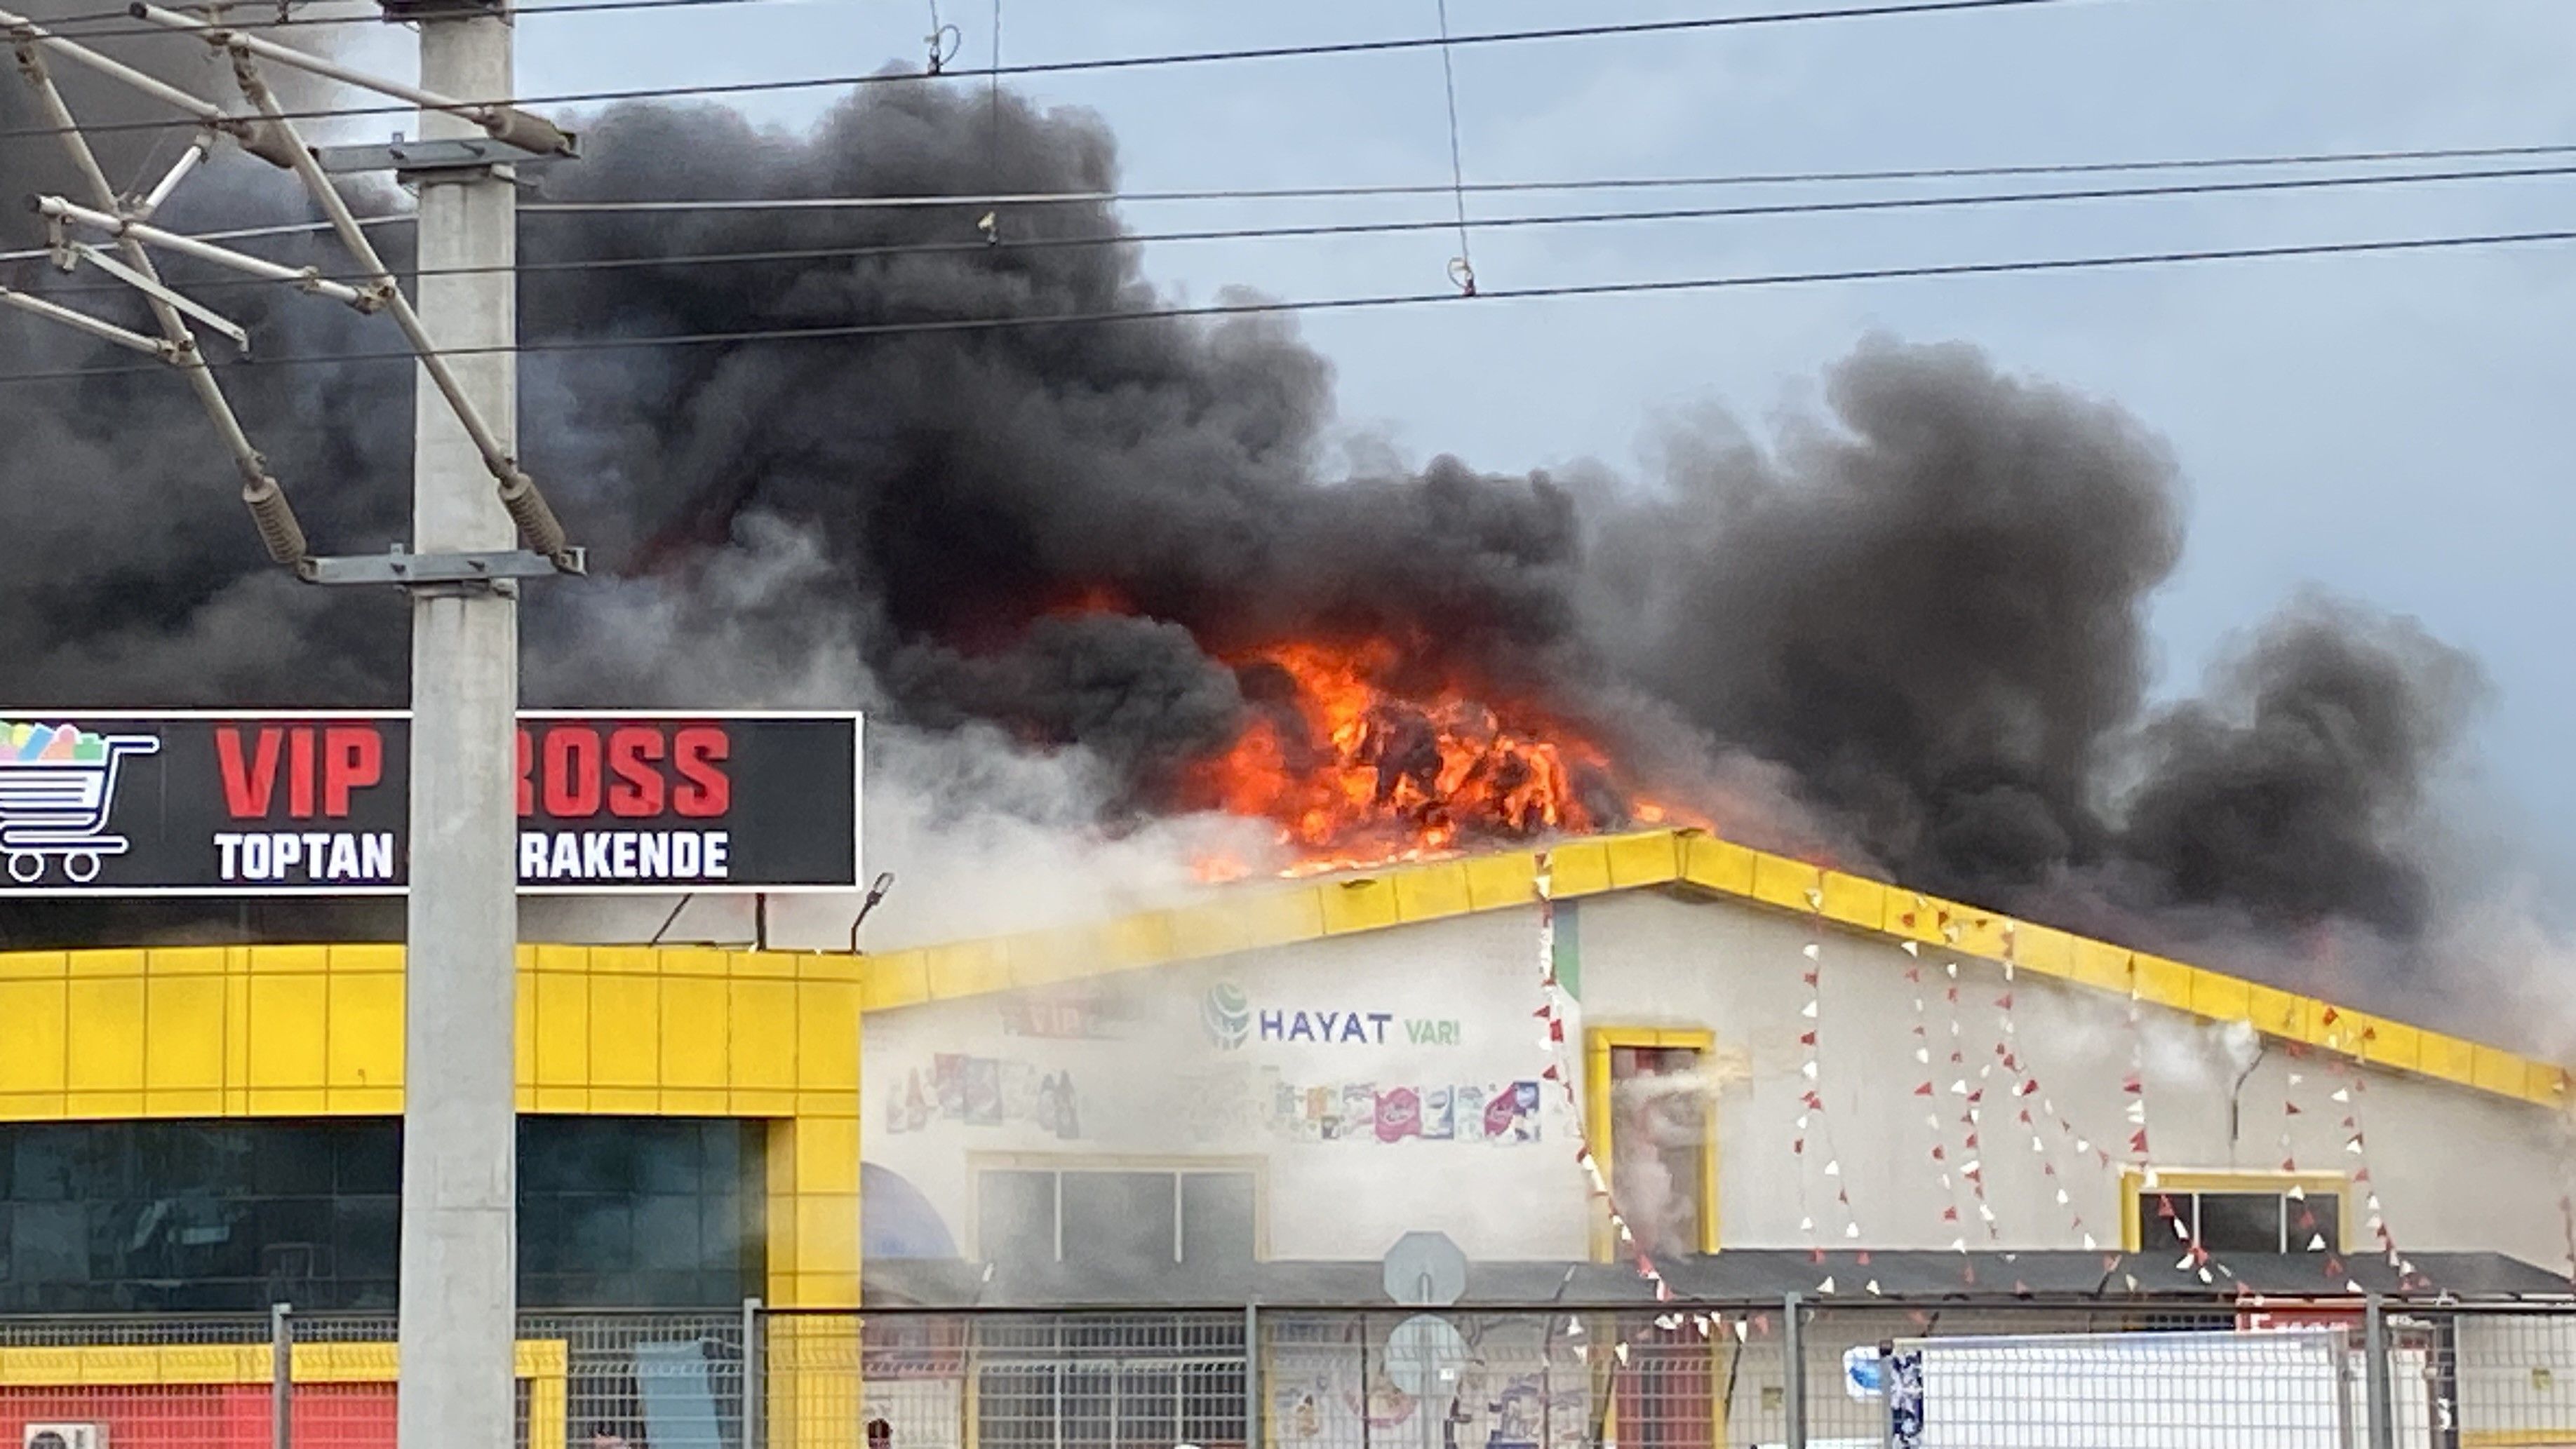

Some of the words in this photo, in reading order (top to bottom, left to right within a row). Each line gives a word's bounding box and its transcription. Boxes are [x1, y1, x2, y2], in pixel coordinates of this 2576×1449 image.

[215, 727, 383, 818] VIP
[516, 726, 730, 818] OSS
[213, 833, 394, 879] TOPTAN
[519, 831, 728, 879] RAKENDE
[1260, 1010, 1393, 1043] HAYAT
